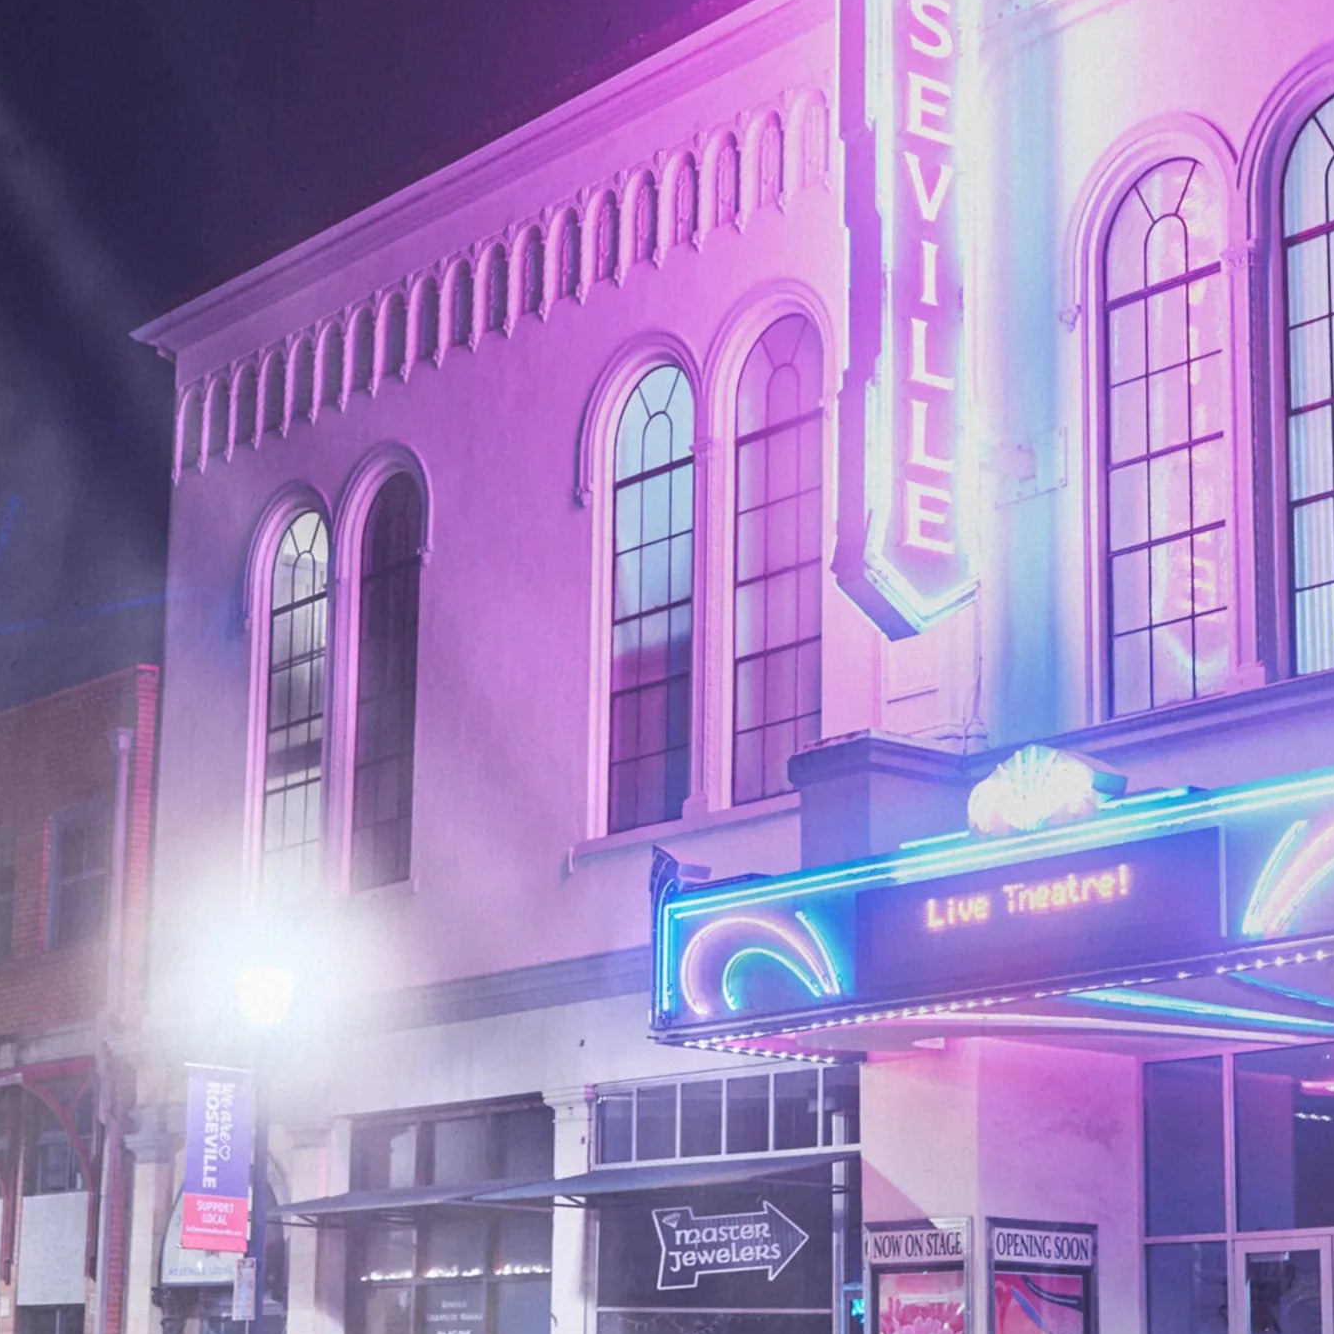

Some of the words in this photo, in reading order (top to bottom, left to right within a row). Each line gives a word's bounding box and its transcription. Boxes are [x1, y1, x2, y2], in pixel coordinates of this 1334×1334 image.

[927, 896, 990, 929] Live
[202, 1082, 221, 1188] ROSEVILLE
[196, 1200, 235, 1214] SUPPORT
[202, 1213, 228, 1226] LOCAL
[873, 1234, 903, 1258] NOW
[905, 1233, 924, 1257] ON
[926, 1231, 962, 1256] STAGE
[996, 1231, 1051, 1259] OPENING
[1054, 1236, 1089, 1261] SOON
